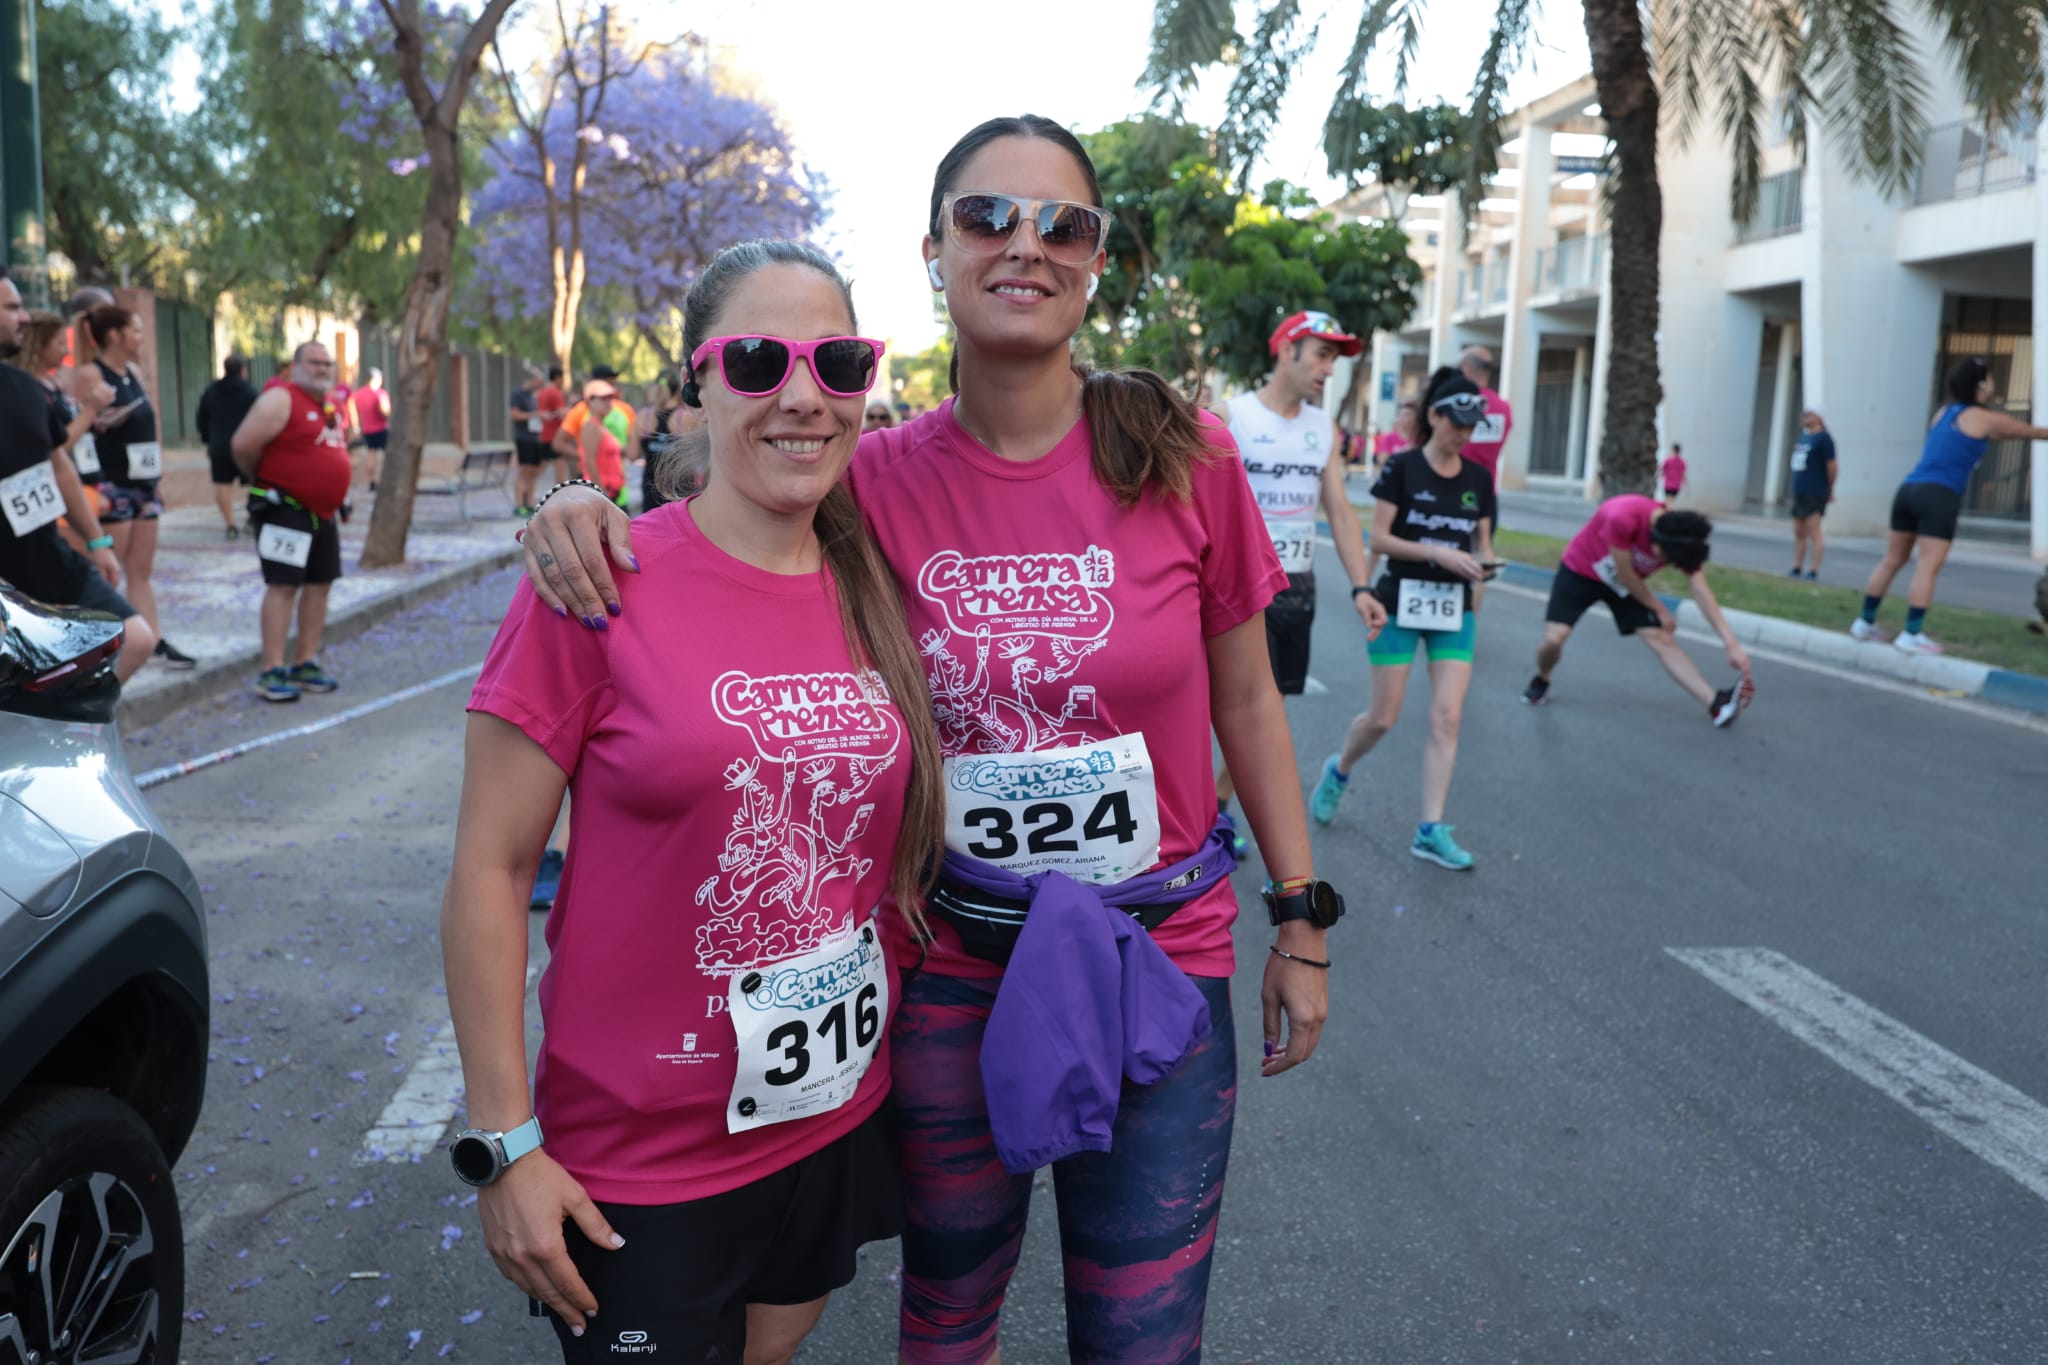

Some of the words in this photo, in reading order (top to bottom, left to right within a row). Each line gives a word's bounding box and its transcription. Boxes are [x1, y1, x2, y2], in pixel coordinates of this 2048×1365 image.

[11, 484, 56, 516] 513
[930, 557, 1081, 588] Carrera
[1084, 551, 1108, 566] de
[1085, 565, 1111, 583] la
[956, 584, 1092, 615] Prensa
[1407, 597, 1456, 618] 216
[725, 676, 864, 711] Carrera
[757, 703, 882, 741] Prensa
[976, 757, 1091, 787] Carrera
[1090, 752, 1109, 763] de
[1093, 760, 1114, 772] la
[999, 775, 1101, 799] Prensa
[964, 790, 1138, 859] 324
[1000, 859, 1041, 870] MARQUEZ
[1042, 857, 1073, 866] GOMEZ,
[1074, 856, 1106, 865] ARIANA
[777, 949, 861, 1001] Carrera
[798, 967, 865, 1007] Prensa
[764, 983, 878, 1086] 316
[800, 1075, 835, 1093] MANCERA
[611, 1343, 656, 1354] Kalenji
